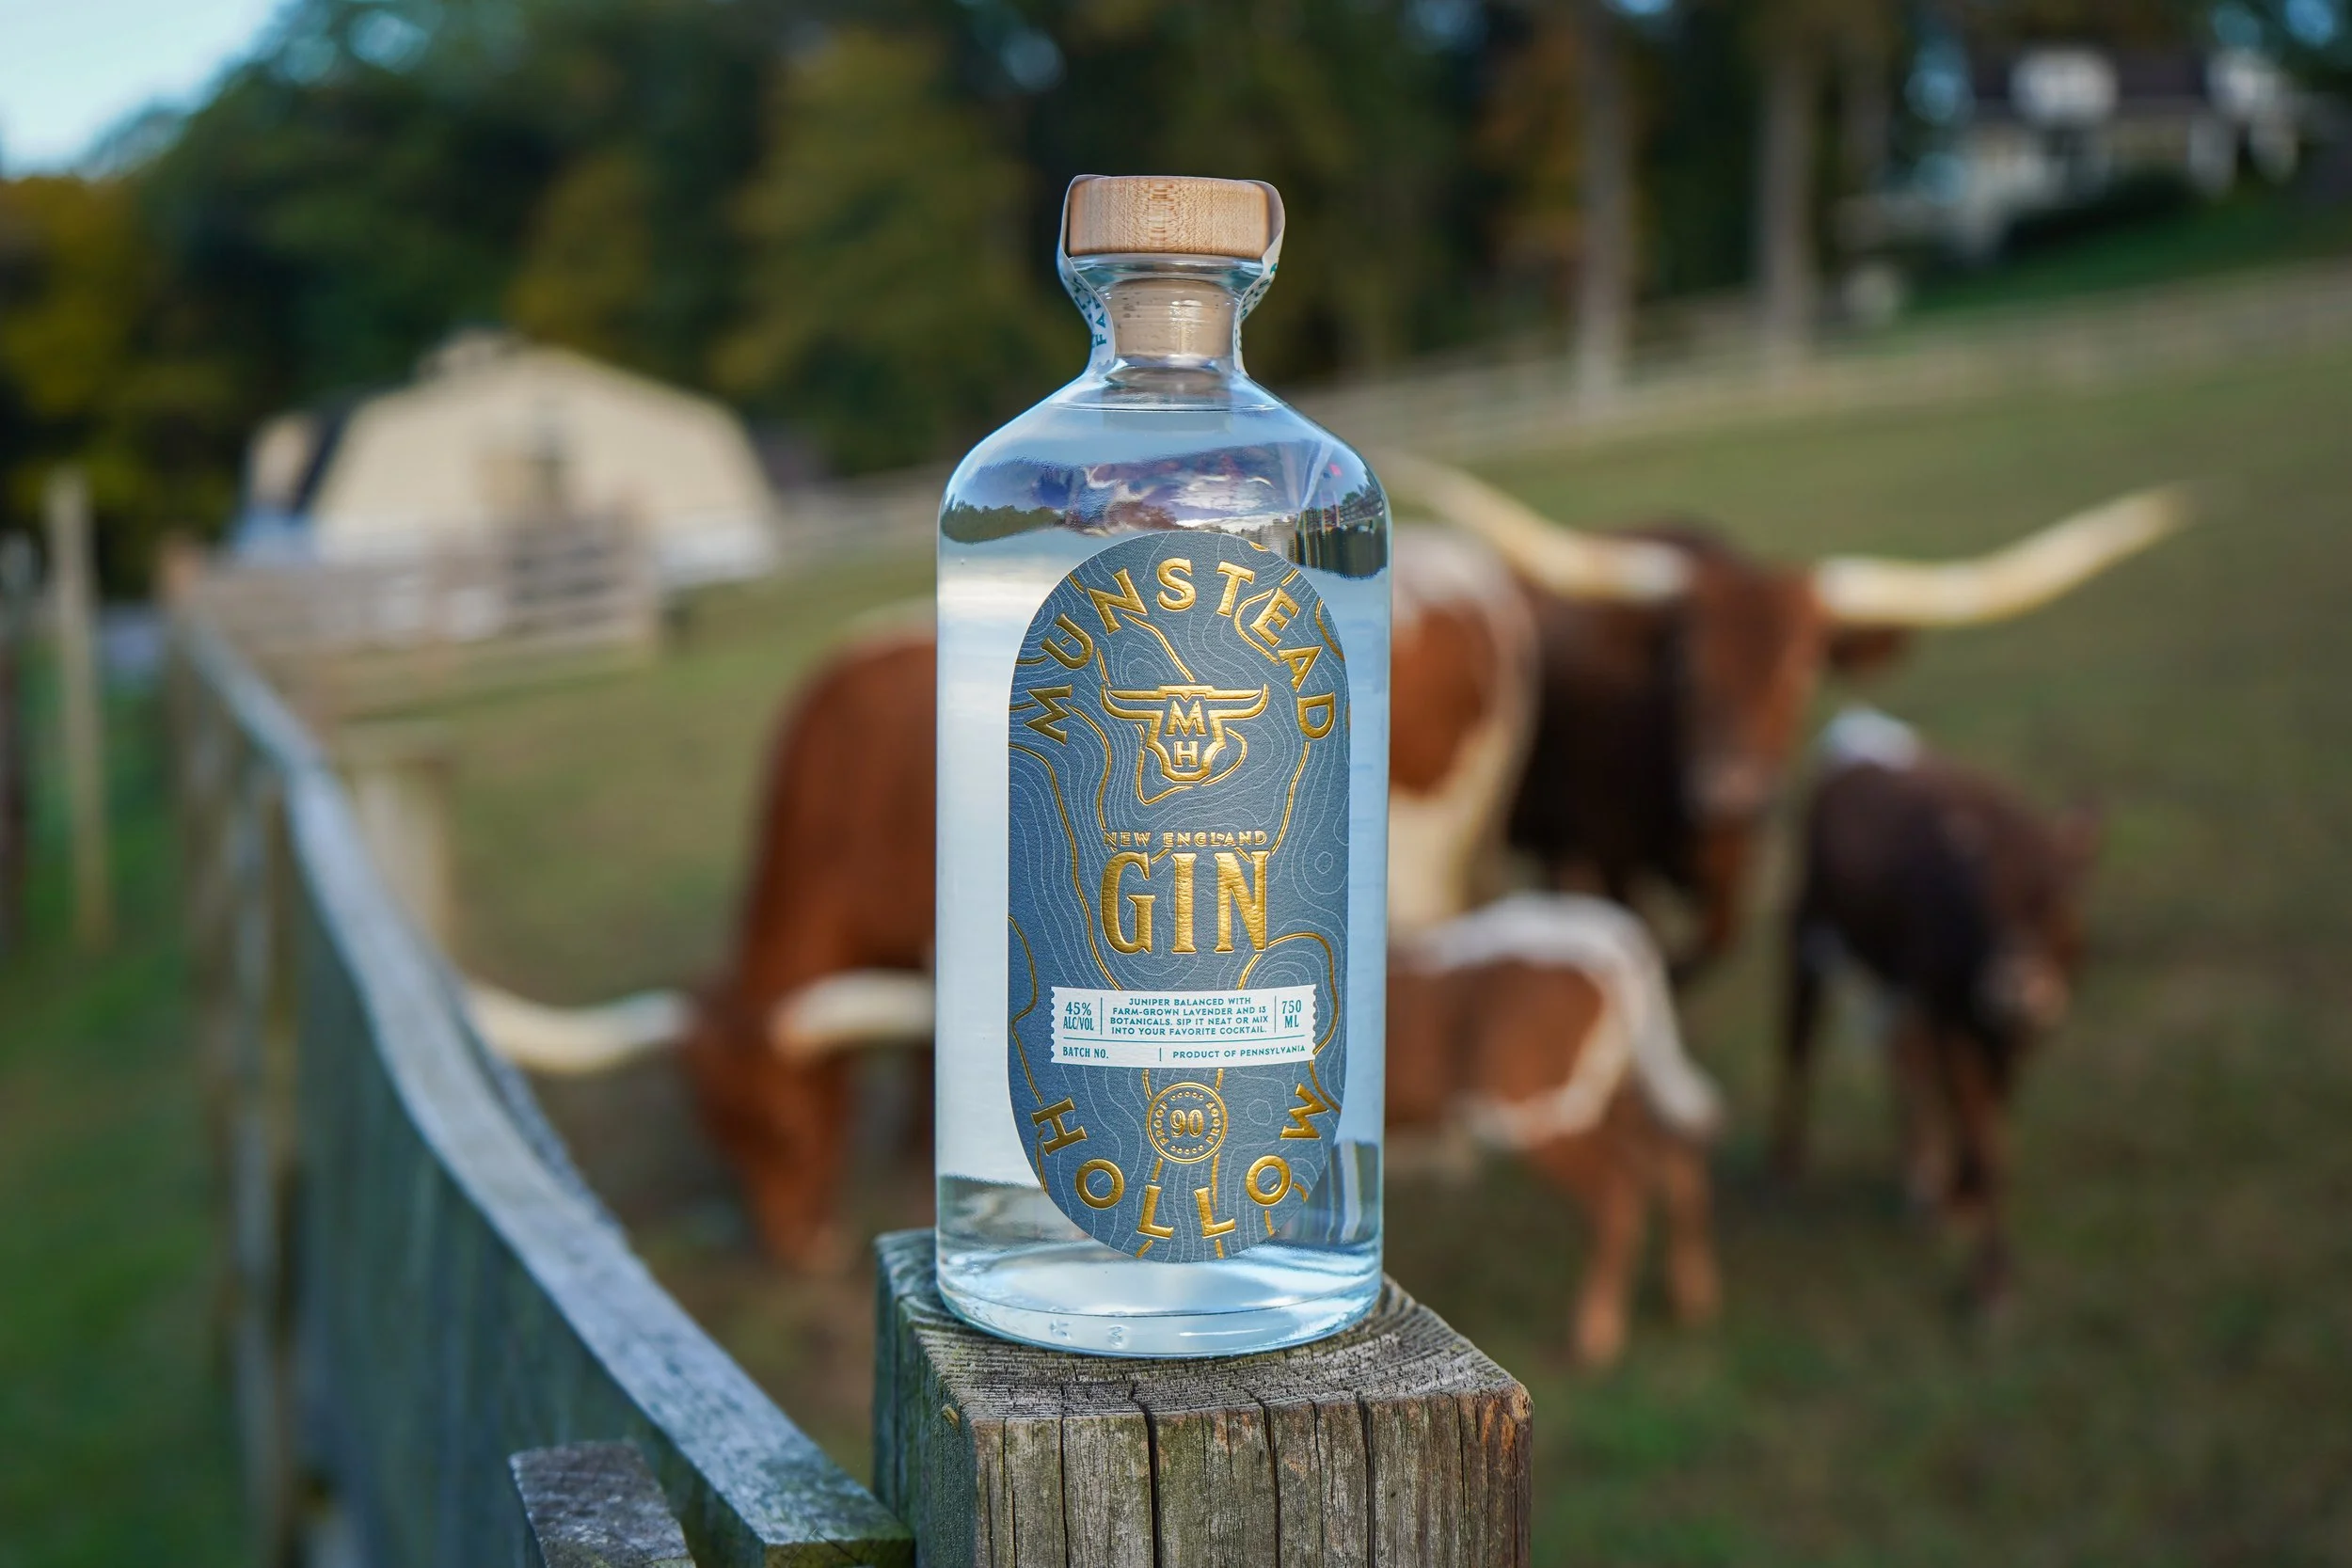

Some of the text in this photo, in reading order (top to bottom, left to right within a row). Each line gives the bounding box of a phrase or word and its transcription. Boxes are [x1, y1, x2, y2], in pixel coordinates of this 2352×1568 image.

[1024, 557, 1336, 746] MUNSTEAD
[1166, 700, 1208, 736] M
[1175, 740, 1200, 768] H
[1104, 830, 1268, 847] NEW ENGLAND
[1101, 850, 1270, 956] GIN
[1065, 1001, 1091, 1016] 45%
[1129, 998, 1170, 1006] JUNIPER
[1174, 998, 1224, 1006] BALANCED
[1281, 999, 1302, 1014] 750
[1113, 1006, 1266, 1016] FARM-GROWN LAVENDER AND 13
[1062, 1015, 1095, 1031] ALC/VOL
[1110, 1017, 1173, 1026] BOTANICALS.
[1176, 1018, 1192, 1026] SIP
[1208, 1017, 1232, 1025] NEAT
[1252, 1015, 1268, 1023] MIX
[1284, 1014, 1299, 1029] ML
[1111, 1025, 1267, 1036] INTO YOUR FAVORITE COCKTAIL.
[1063, 1046, 1109, 1059] BATCH NO.
[1172, 1045, 1306, 1058] PRODUCT OF PENNSYLVANIA
[1153, 1101, 1169, 1146] PROOF
[1170, 1109, 1204, 1138] 90
[1205, 1101, 1221, 1145] PROOF
[1031, 1083, 1328, 1239] HOLLOW
